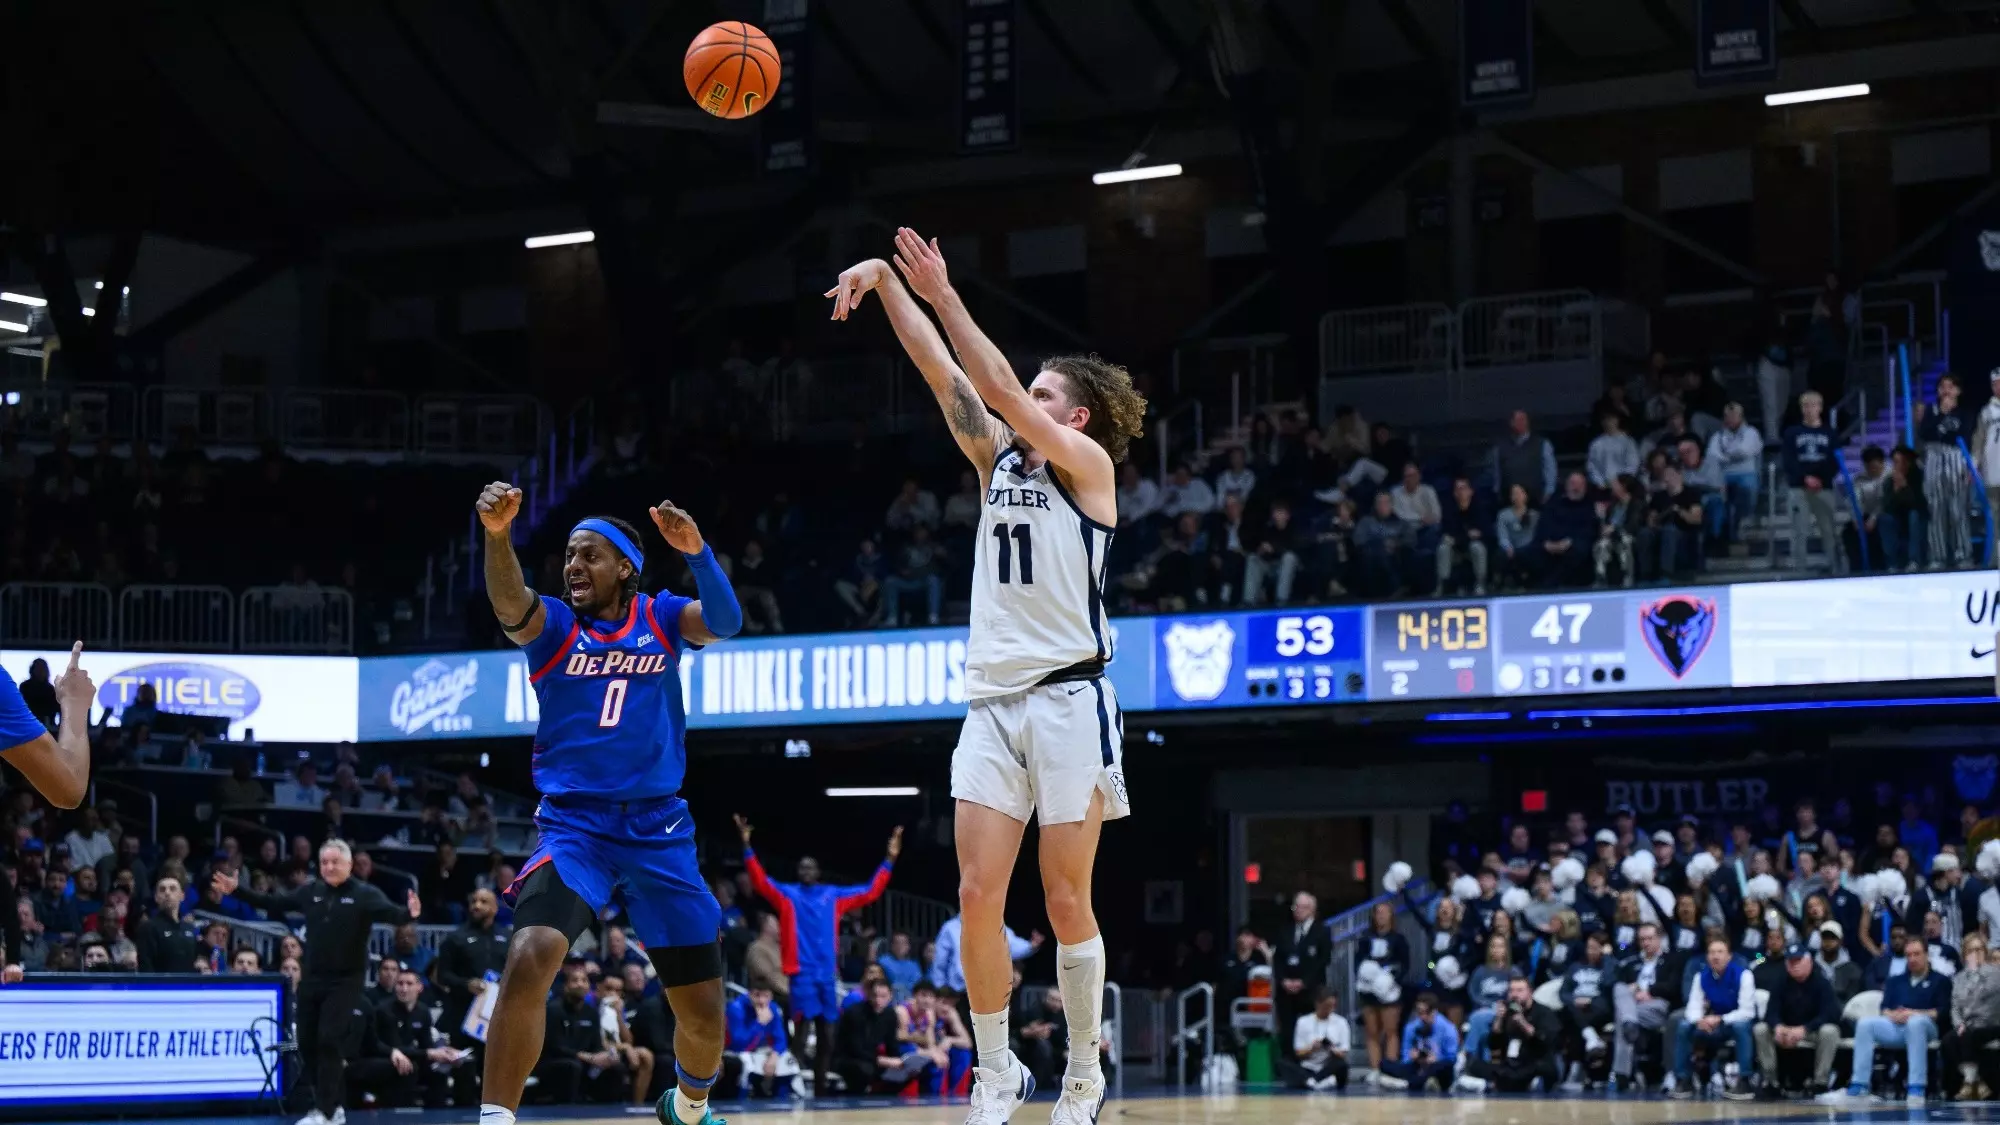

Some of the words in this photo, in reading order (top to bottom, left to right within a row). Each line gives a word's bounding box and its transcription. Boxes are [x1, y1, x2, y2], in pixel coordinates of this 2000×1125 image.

[988, 488, 1051, 511] UTLER
[993, 523, 1033, 584] 11
[1276, 615, 1334, 657] 53
[1398, 608, 1487, 652] 14:03
[1531, 602, 1592, 644] 47
[702, 648, 804, 714] HINKLE
[812, 639, 970, 710] FIELDHOUS
[1288, 678, 1304, 699] 3
[1317, 677, 1330, 698] 3
[1391, 671, 1409, 695] 2
[1534, 667, 1550, 688] 3
[1564, 666, 1581, 686] 4
[599, 679, 628, 727] 0
[1606, 778, 1769, 814] BUTLER
[43, 1031, 80, 1059] FOR
[87, 1030, 160, 1058] BUTLER
